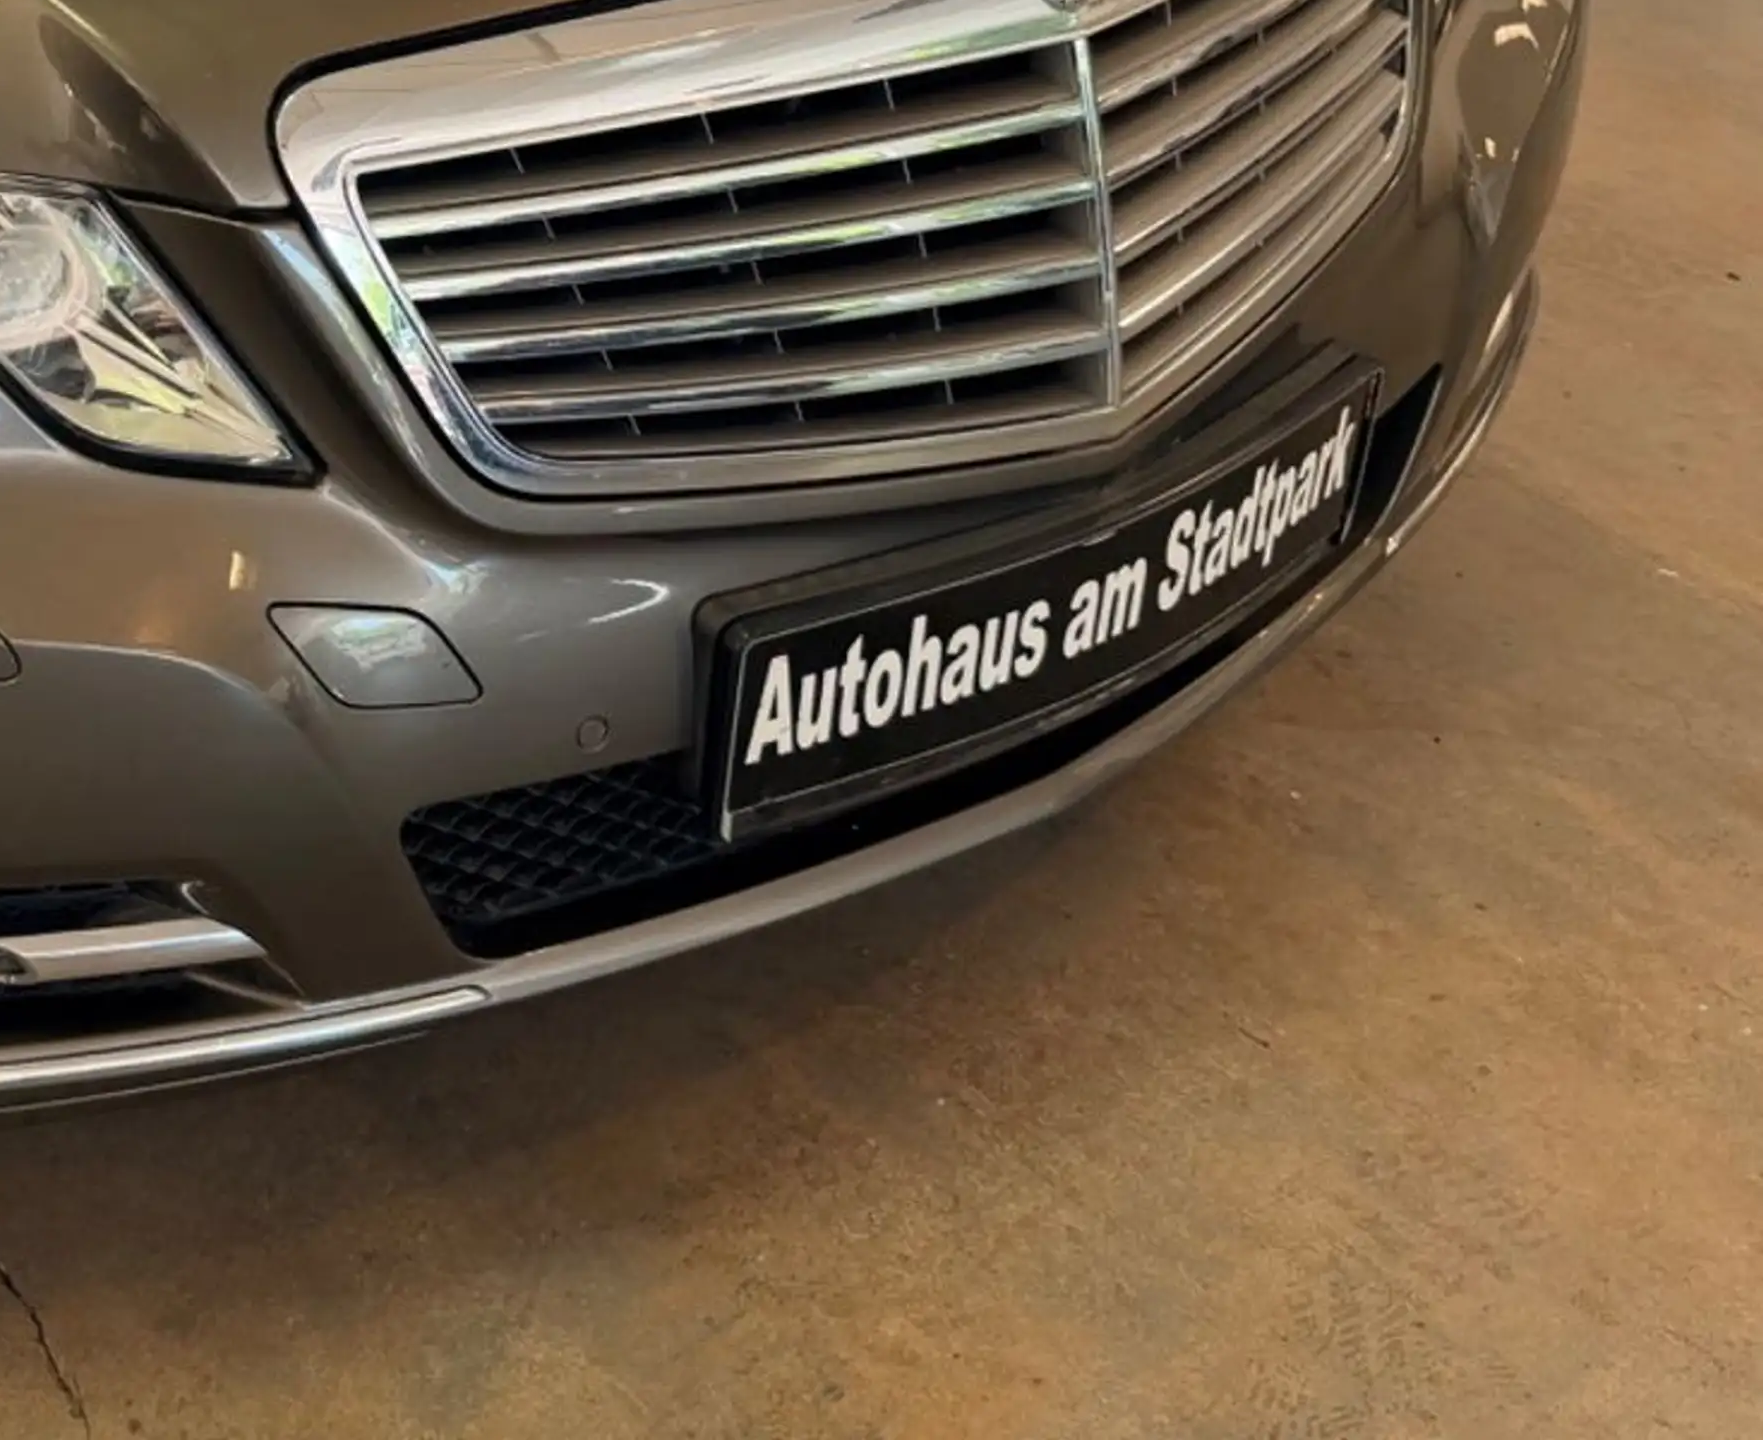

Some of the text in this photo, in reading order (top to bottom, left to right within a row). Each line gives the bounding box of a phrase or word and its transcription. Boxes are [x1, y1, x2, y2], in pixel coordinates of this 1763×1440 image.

[744, 404, 1357, 766] Autohaus am Stadtpark
